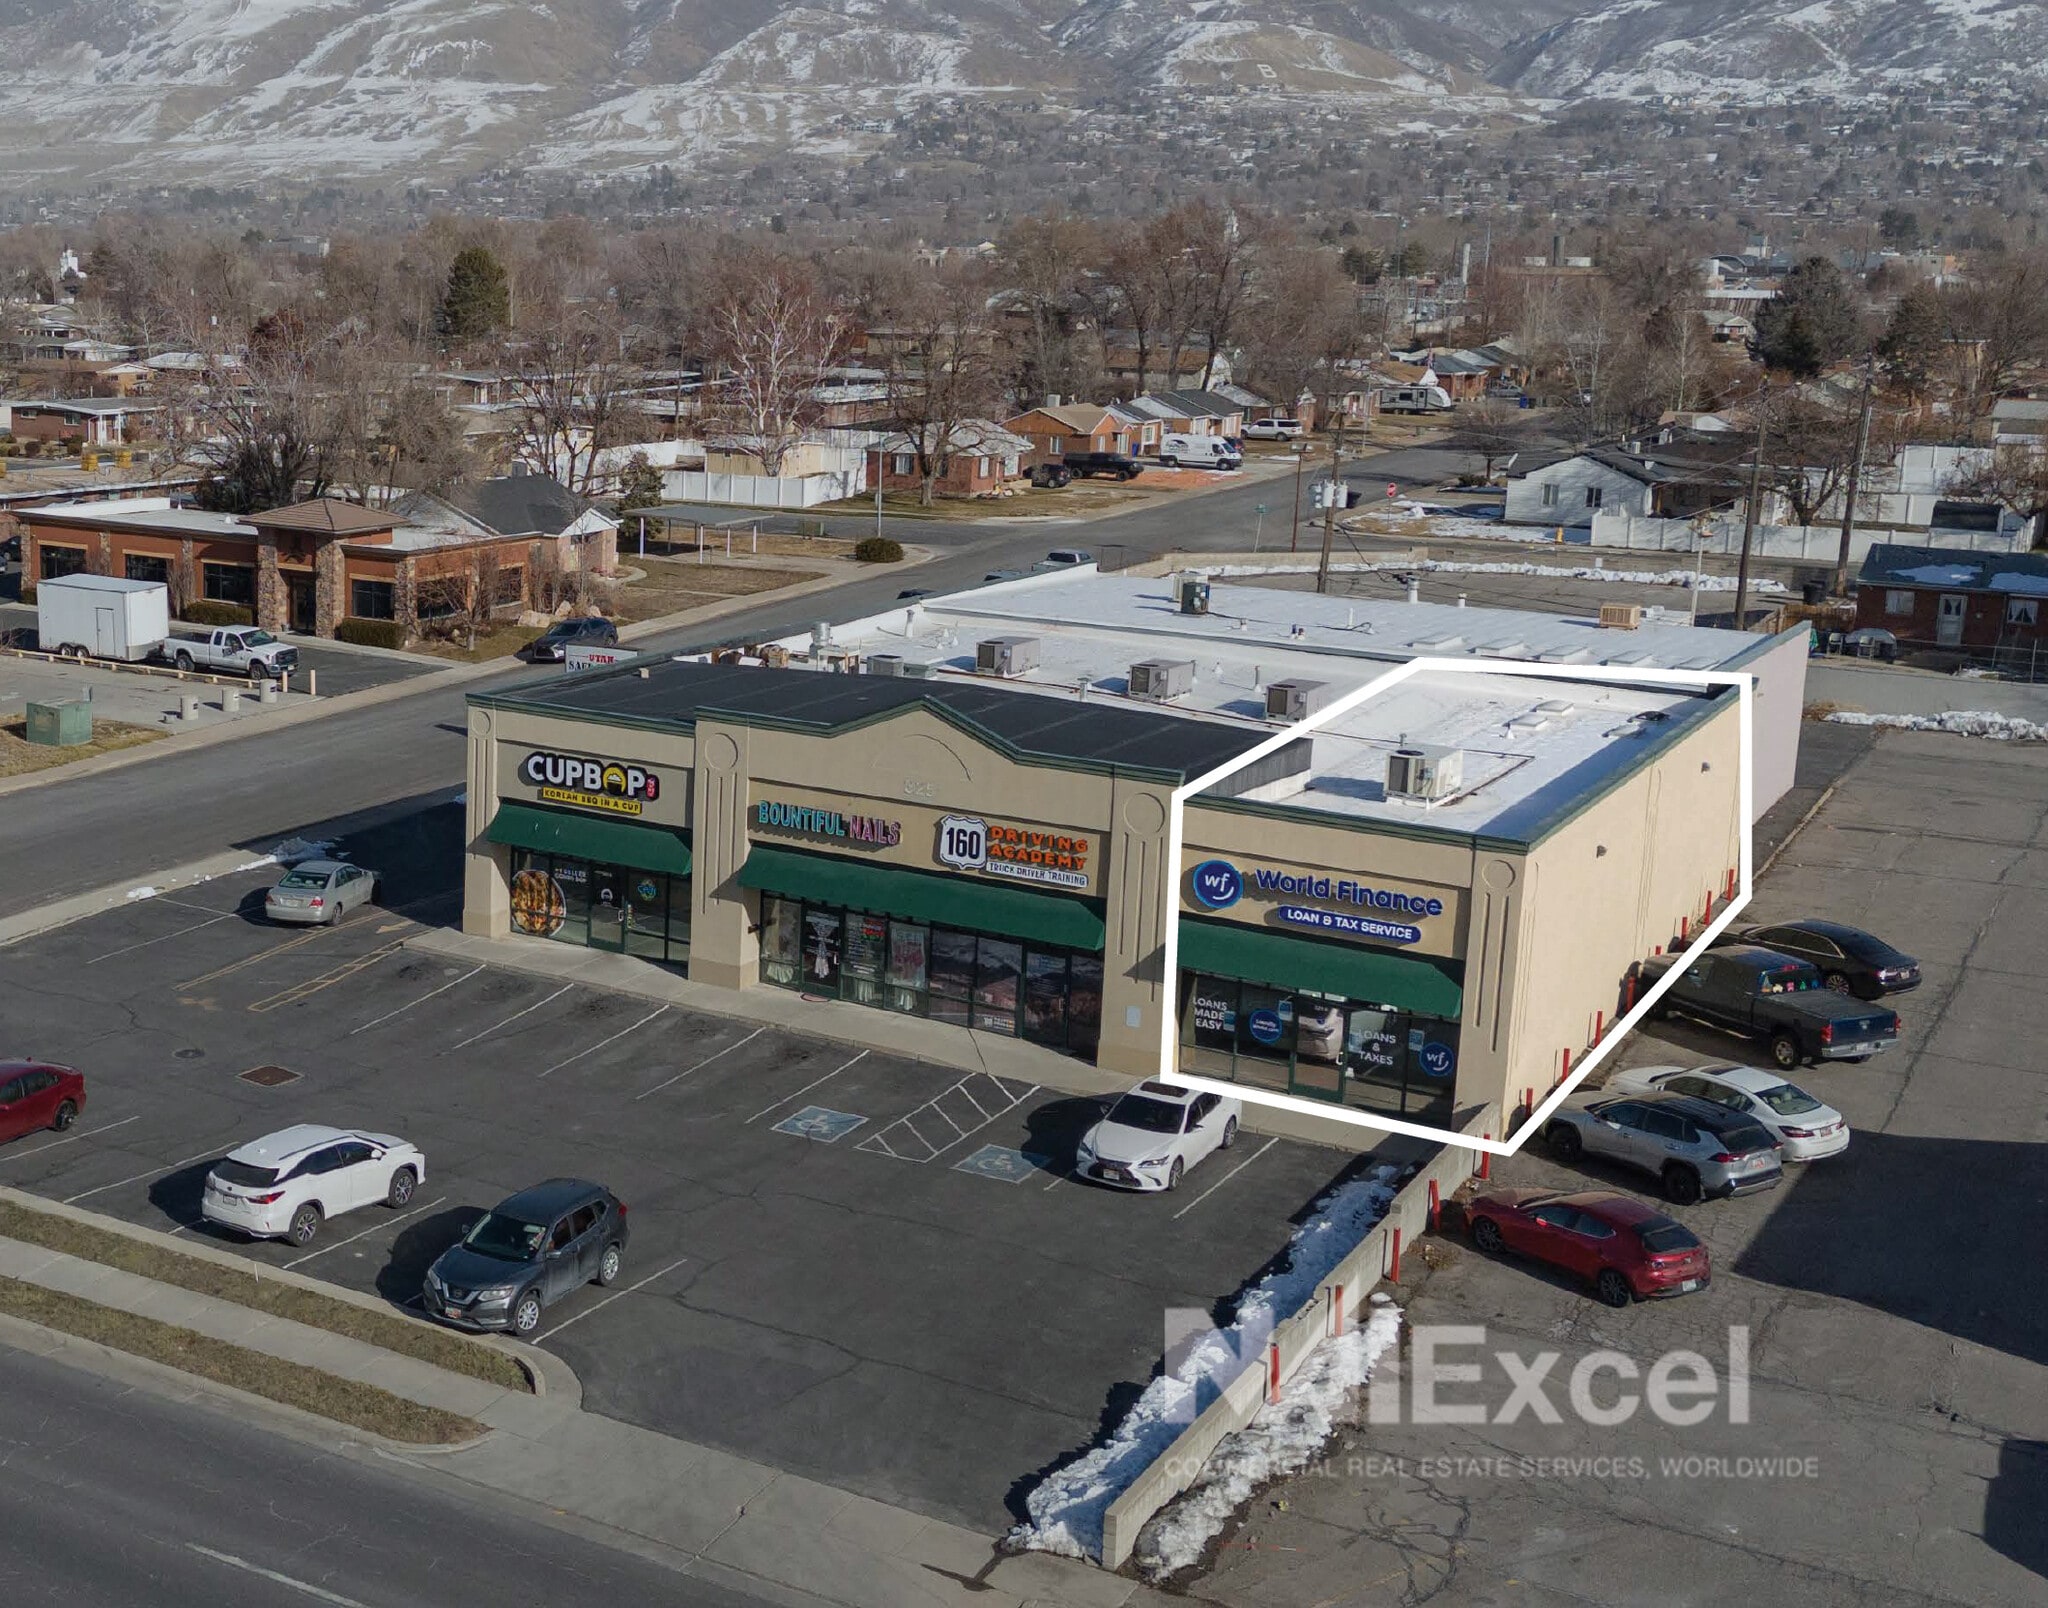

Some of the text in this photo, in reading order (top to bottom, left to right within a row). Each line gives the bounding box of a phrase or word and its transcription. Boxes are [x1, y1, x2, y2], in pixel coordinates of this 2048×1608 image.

[527, 755, 646, 796] CUPBOP
[544, 789, 578, 801] KOREAN
[581, 795, 598, 805] BBQ
[601, 798, 610, 807] IN
[622, 802, 639, 812] CUP
[758, 800, 902, 845] BOUNTIFUL NAILS
[946, 827, 981, 859] 160
[990, 826, 1088, 853] DRIVING
[989, 843, 1087, 870] ACADEMY
[989, 862, 1086, 886] TRUCK DRIVER TRAINING
[1204, 872, 1231, 892] wf
[1255, 869, 1443, 916] World Finance
[1287, 909, 1413, 939] LOAN & TAX SERVICE
[1192, 995, 1228, 1011] LOANS
[1194, 1007, 1225, 1020] MADE
[1195, 1018, 1222, 1030] EASY
[1360, 1050, 1394, 1065] TAXES
[1372, 1042, 1380, 1052] &
